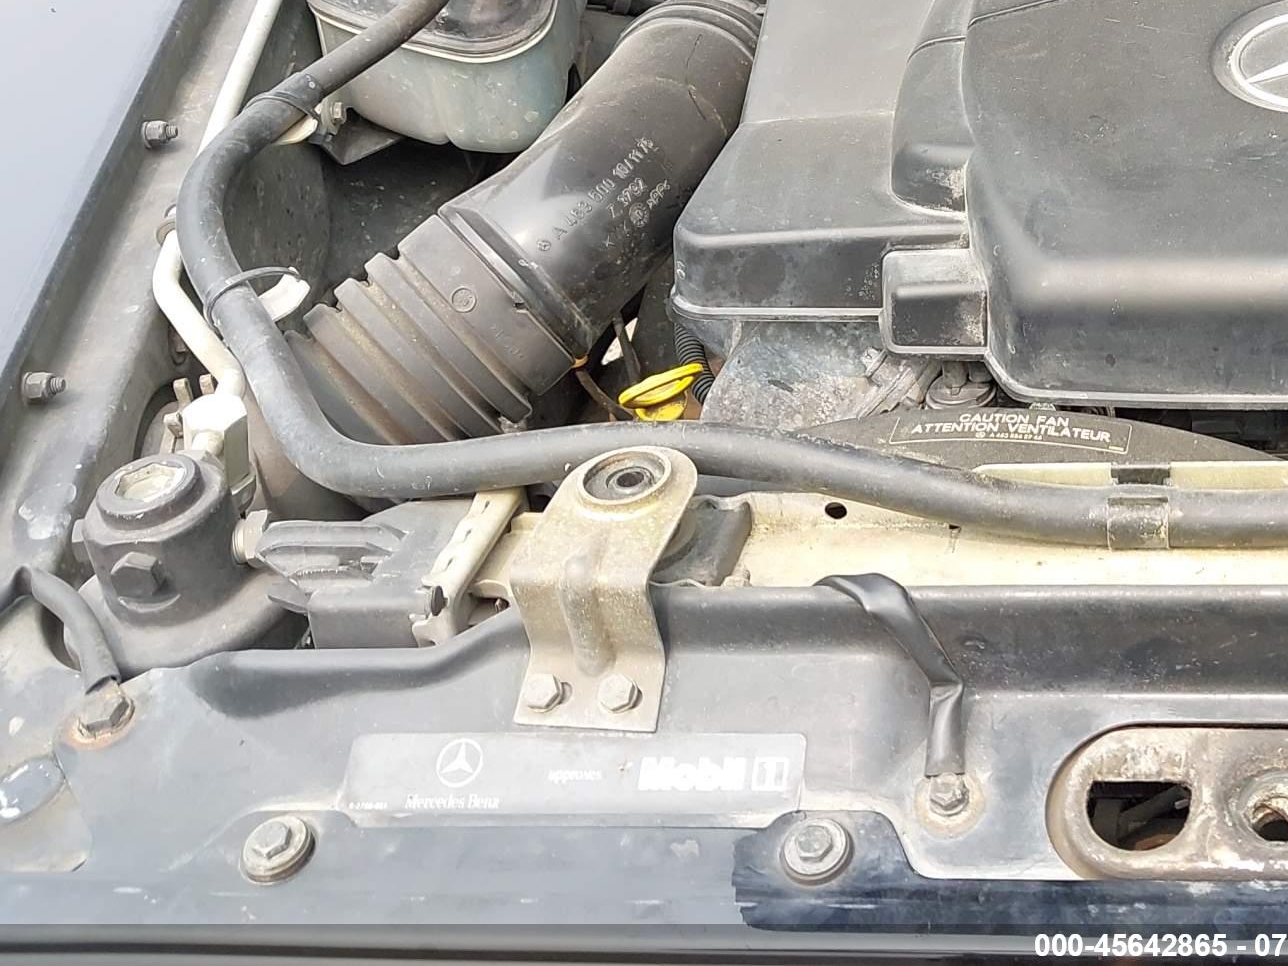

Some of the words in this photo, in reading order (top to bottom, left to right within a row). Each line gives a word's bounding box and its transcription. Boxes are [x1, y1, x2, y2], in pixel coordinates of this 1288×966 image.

[959, 413, 1030, 424] CAUTION
[1036, 415, 1070, 427] FAN
[911, 422, 999, 434] ATTENTION
[1007, 423, 1112, 443] VENTILATEUR
[548, 768, 602, 785] approves
[637, 755, 747, 792] Mobil
[405, 793, 465, 809] Mercedes
